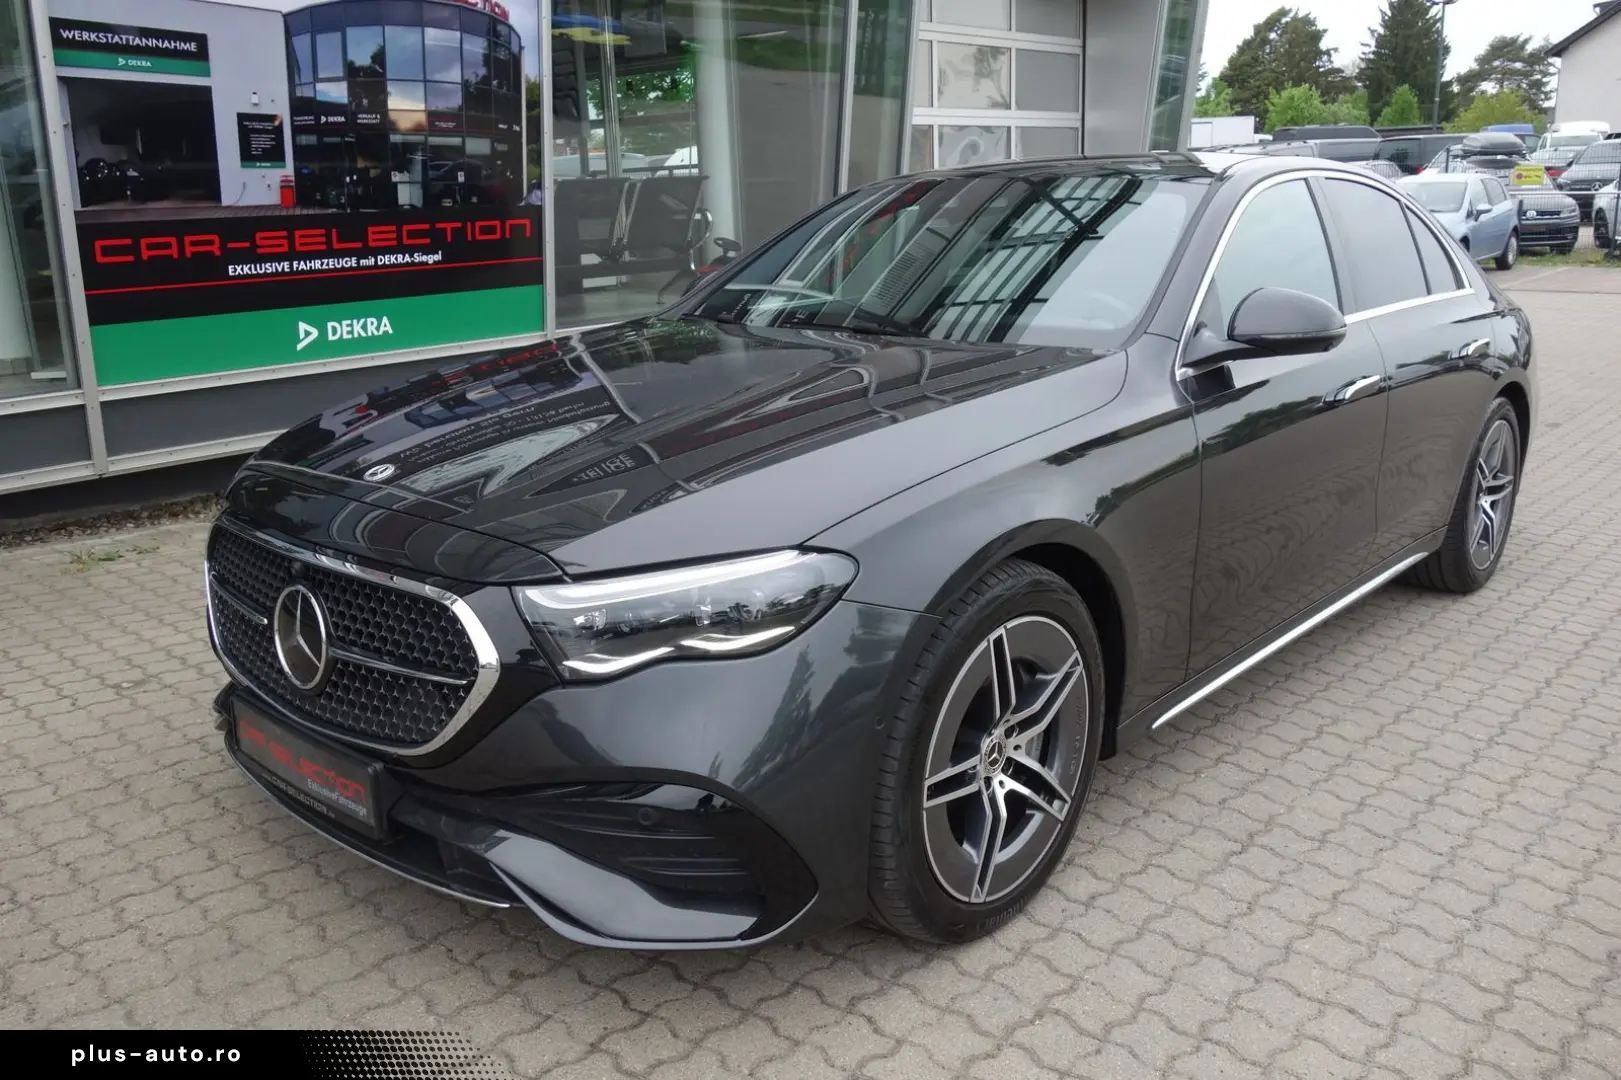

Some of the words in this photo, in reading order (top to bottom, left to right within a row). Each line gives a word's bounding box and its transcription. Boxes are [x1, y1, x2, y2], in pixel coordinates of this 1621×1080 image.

[60, 28, 198, 52] WERKSTATTANNAHME
[127, 59, 152, 67] DEKRA
[94, 218, 532, 263] CAR-SELECTION
[228, 261, 290, 276] EXKLUSIVE
[292, 256, 358, 272] FAHRZEUGE
[359, 255, 376, 267] mit
[378, 250, 442, 266] DEKRA-Siegel
[328, 315, 393, 341] DEKRA
